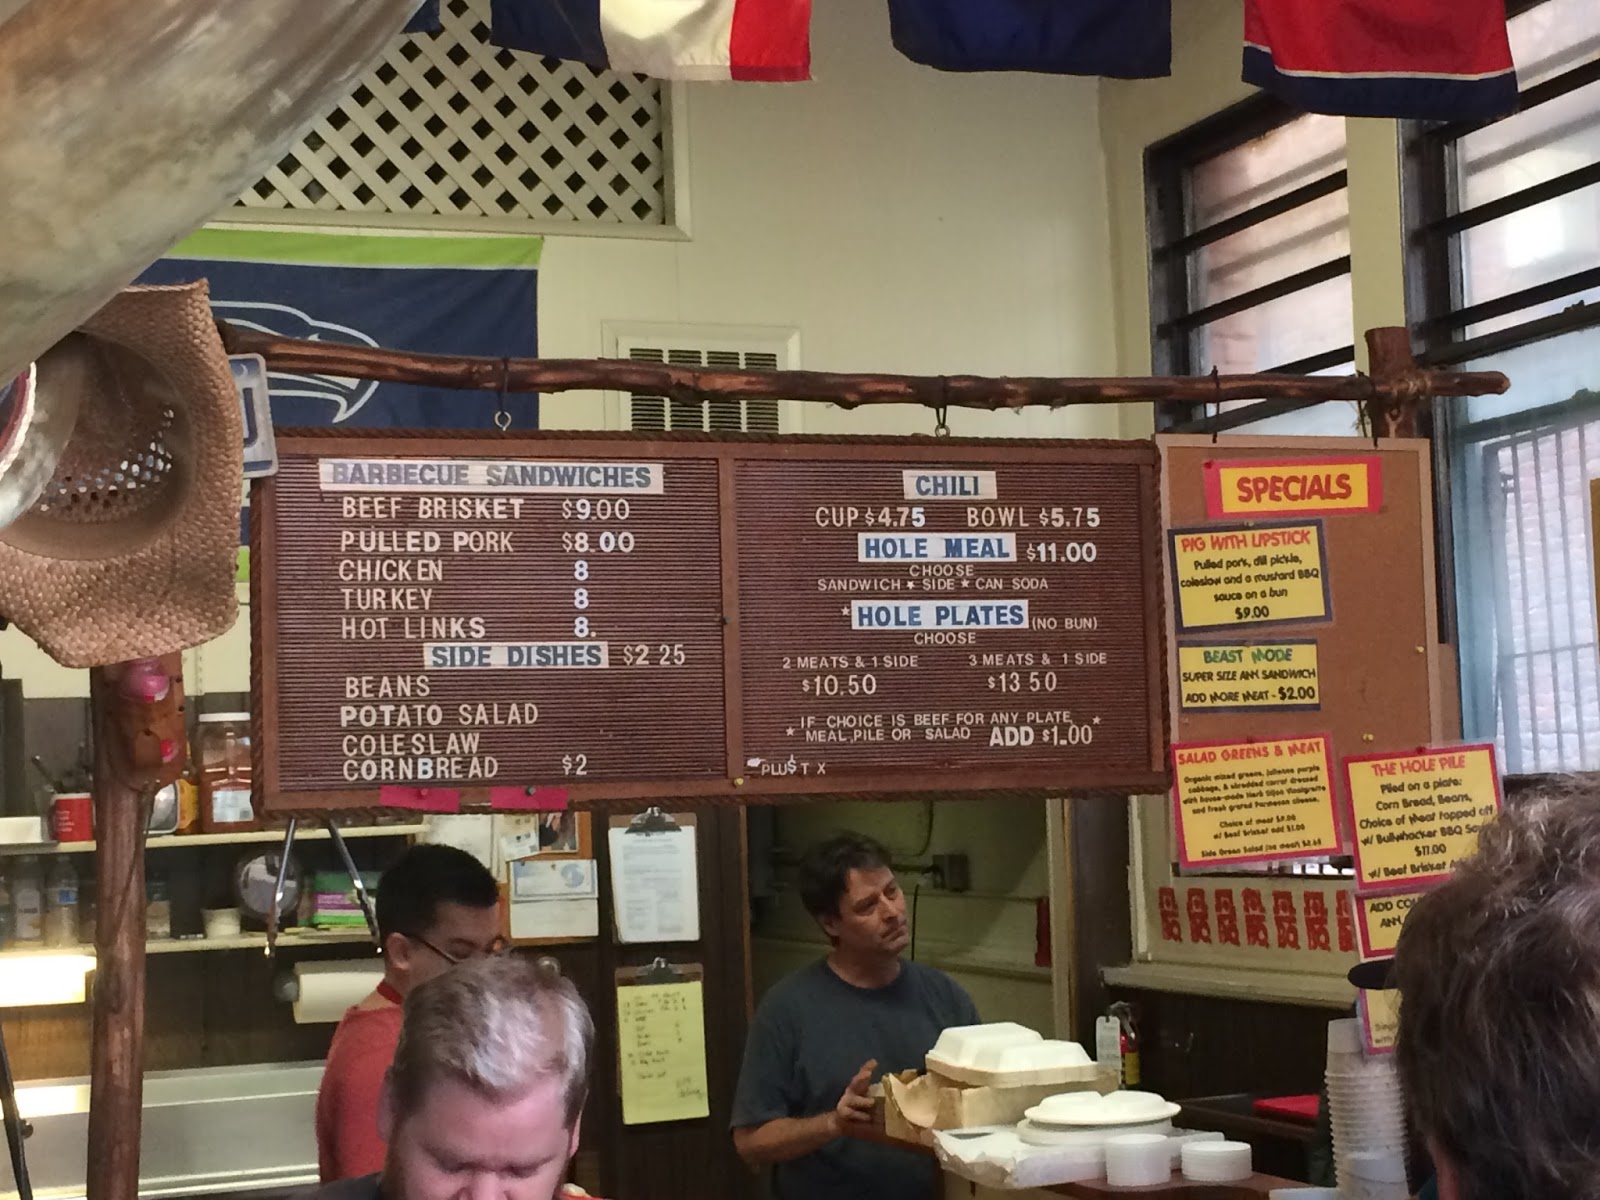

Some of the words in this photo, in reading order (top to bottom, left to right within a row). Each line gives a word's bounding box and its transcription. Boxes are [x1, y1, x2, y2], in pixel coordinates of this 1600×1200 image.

[333, 463, 469, 485] BARBECUE
[487, 466, 651, 488] SANDWICHES
[916, 476, 979, 496] CHILI
[1236, 474, 1352, 503] SPECIALS
[342, 498, 401, 519] BEEF
[419, 498, 524, 519] BRISKET
[562, 498, 630, 521] $9.00
[816, 507, 859, 528] CUP
[864, 507, 925, 528] $4.75
[967, 507, 1029, 527] BOWL
[1039, 507, 1100, 527] $5.75
[341, 531, 440, 552] PULLED
[453, 531, 513, 552] PORK
[562, 532, 635, 553] $8.00
[865, 538, 928, 558] HOLE
[945, 538, 1009, 558] MEAL
[1026, 542, 1096, 562] $11.00
[1181, 537, 1206, 552] PIG
[1211, 534, 1247, 550] WITH
[1252, 530, 1311, 548] LIPSTICK
[338, 559, 443, 582] CHICKEN
[574, 560, 588, 581] 8
[909, 565, 974, 577] CHOOSE
[1194, 558, 1223, 570] Pulled
[1226, 557, 1252, 569] pork,
[1254, 555, 1267, 566] dill
[1270, 554, 1302, 566] pickle,
[817, 579, 900, 591] SANDWICH
[922, 578, 954, 591] SIDE
[975, 578, 1003, 590] CAN
[1012, 578, 1048, 590] SODA
[1180, 576, 1221, 588] coleslaw
[1224, 573, 1242, 584] and
[1254, 570, 1295, 582] mustard
[1298, 568, 1319, 579] BBQ
[341, 588, 433, 610] TURKEY
[574, 588, 588, 609] 8
[1214, 593, 1242, 602] sauce
[1245, 591, 1257, 600] on
[1269, 587, 1288, 597] bun
[859, 606, 921, 627] HOLE
[936, 605, 1023, 625] PLATES
[1032, 617, 1057, 631] (NO
[1065, 616, 1098, 630] BUN)
[1235, 605, 1269, 620] $9.00
[342, 618, 390, 639] HOT
[404, 617, 485, 638] LINKS
[914, 632, 976, 645] CHOOSE
[431, 646, 492, 666] SIDE
[508, 645, 601, 666] DISHES
[783, 657, 791, 670] 2
[797, 656, 849, 669] MEATS
[855, 656, 864, 668] &
[871, 656, 877, 668] 1
[883, 655, 918, 667] SIDE
[969, 654, 978, 666] 3
[982, 653, 1033, 666] MEATS
[1041, 653, 1050, 665] &
[1062, 653, 1068, 665] 1
[1075, 652, 1107, 665] SIDE
[1204, 650, 1243, 664] BEAST
[1252, 648, 1292, 663] MODE
[802, 673, 876, 697] $10.50
[1183, 670, 1213, 682] SUPER
[1217, 670, 1236, 681] SIZE
[1240, 669, 1259, 681] ANY
[1262, 668, 1316, 680] SANDWICH
[346, 676, 430, 698] BEANS
[1185, 693, 1206, 703] ADD
[1210, 691, 1239, 704] MORE
[1243, 690, 1269, 702] MEAT
[1278, 686, 1315, 700] $2.00
[341, 705, 442, 727] POTATO
[458, 704, 538, 725] SALAD
[801, 716, 815, 728] IF
[827, 715, 882, 728] CHOICE
[891, 714, 905, 727] IS
[914, 713, 949, 726] BEEF
[956, 713, 984, 725] FOR
[990, 712, 1018, 725] ANY
[342, 732, 479, 756] COLESLAW
[892, 728, 911, 741] OR
[924, 727, 971, 740] SALAD
[989, 726, 1034, 747] ADD
[1042, 725, 1092, 745] $1.00
[1178, 751, 1216, 765] SALAD
[1221, 747, 1269, 761] GREENS
[1288, 741, 1321, 757] MEAT
[343, 757, 498, 781] CORNBREAD
[562, 754, 587, 777] $2
[1371, 763, 1397, 777] THE
[1400, 759, 1436, 775] HOLE
[1438, 755, 1465, 771] PILE
[1184, 774, 1212, 784] Organic
[1380, 782, 1404, 794] Piled
[1408, 782, 1420, 791] on
[1423, 781, 1430, 789] a
[1376, 800, 1399, 811] Corn
[1402, 796, 1435, 808] Bread,
[1438, 793, 1472, 804] Beans,
[1220, 819, 1243, 828] Choice
[1246, 818, 1253, 826] of
[1359, 816, 1392, 830] Choice
[1396, 816, 1405, 826] of
[1409, 812, 1435, 825] Meat
[1439, 807, 1476, 822] topped
[1361, 834, 1373, 846] w/
[1376, 829, 1437, 845] Bullwhacker
[1440, 825, 1463, 837] BBQ
[1414, 843, 1446, 857] $11.00
[1369, 867, 1381, 879] w/
[1384, 864, 1407, 877] Beef
[1410, 861, 1446, 874] Brisket
[1370, 901, 1393, 913] ADD
